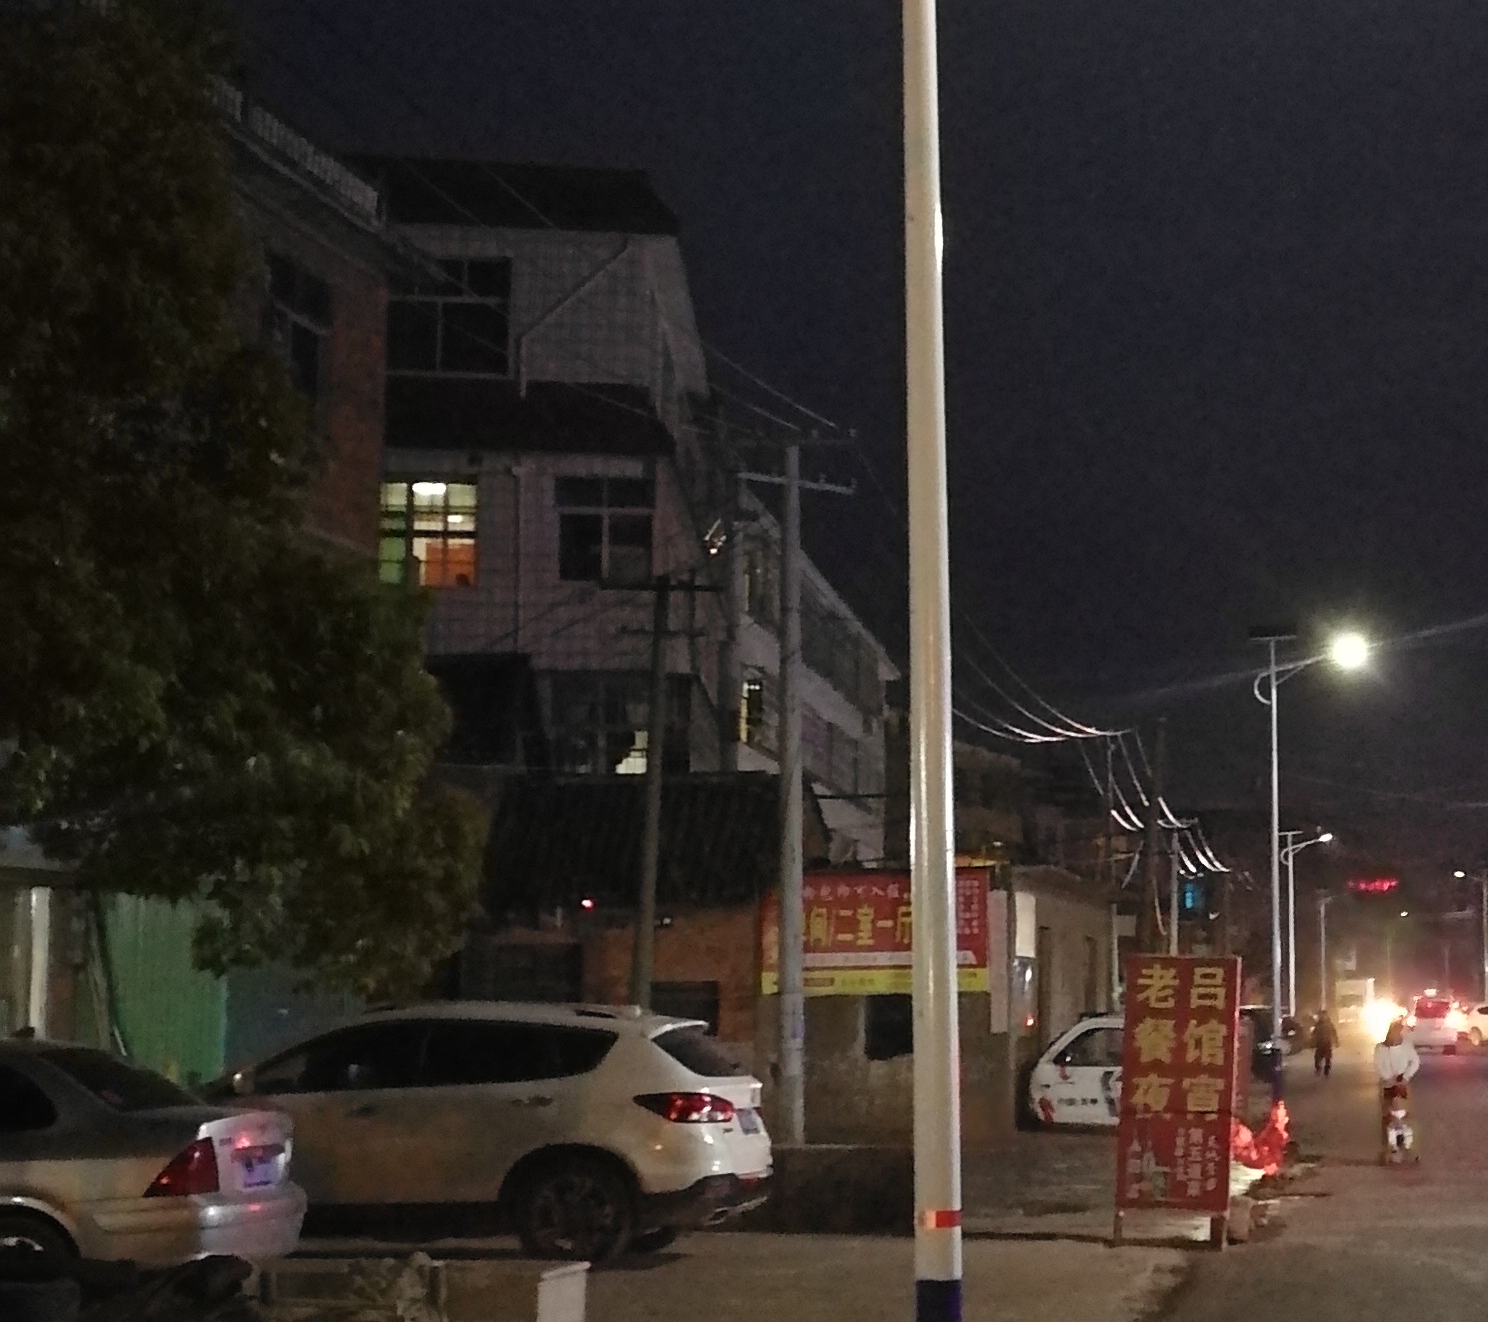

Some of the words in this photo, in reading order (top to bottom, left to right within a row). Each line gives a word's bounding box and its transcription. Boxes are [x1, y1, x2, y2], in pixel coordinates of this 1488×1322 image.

[1136, 963, 1227, 1010] 老吕
[1132, 1016, 1227, 1065] 餐馆
[1130, 1073, 1227, 1120] 夜宵
